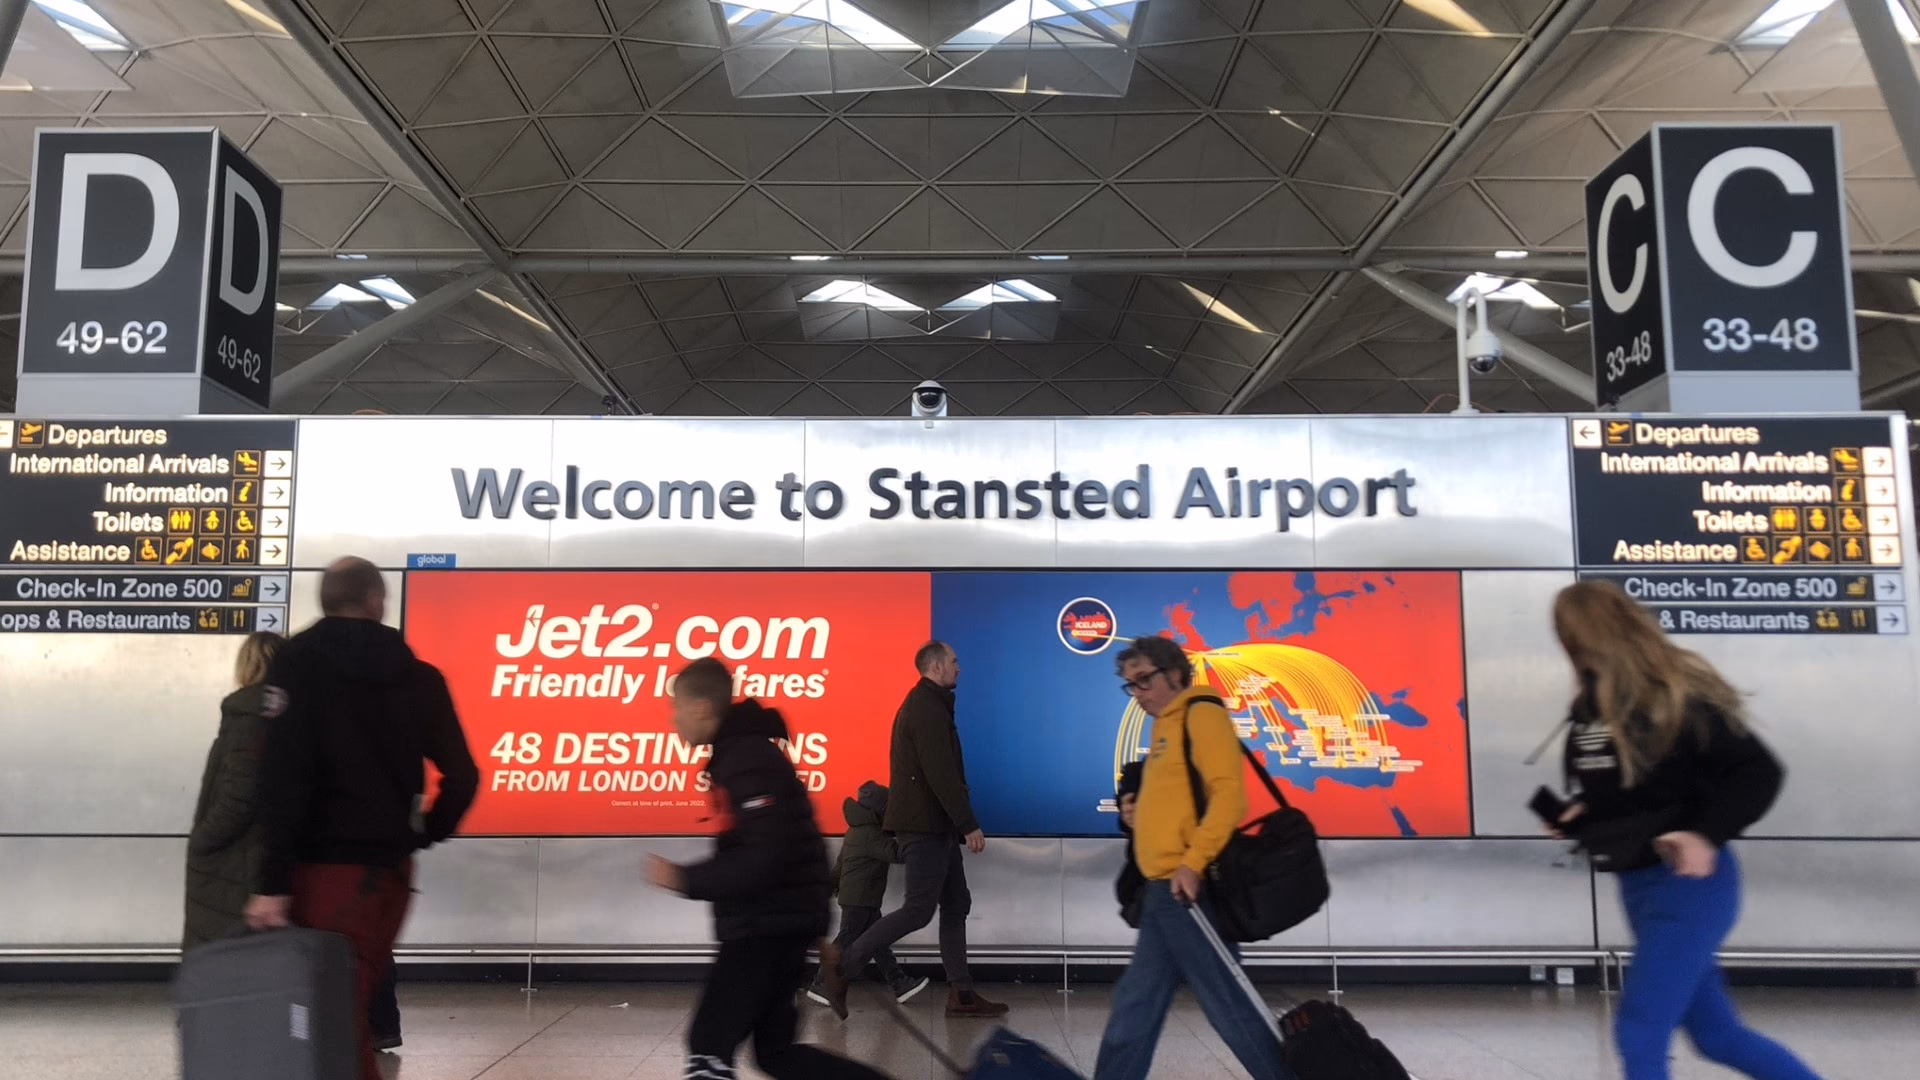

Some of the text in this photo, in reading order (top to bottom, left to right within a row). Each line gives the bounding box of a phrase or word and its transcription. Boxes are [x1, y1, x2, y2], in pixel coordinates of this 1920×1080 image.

[54, 152, 180, 291] D
[1687, 146, 1818, 288] C
[219, 165, 269, 315] D
[1597, 173, 1648, 314] C
[56, 320, 168, 354] 49-62
[1702, 317, 1819, 352] 33-48
[217, 334, 262, 384] 49-62
[1606, 330, 1652, 382] 33-48
[48, 424, 168, 449] Departures
[1635, 423, 1760, 447] Departures
[10, 453, 230, 474] International Arrivals
[1601, 452, 1829, 473] International Arrivals
[104, 482, 229, 503] Information
[451, 463, 1418, 532] Welcome to Stansted Airport
[1702, 481, 1832, 503] Information
[93, 511, 165, 533] Toilets
[1692, 509, 1769, 532] Toilets
[9, 540, 131, 561] Assistance
[417, 554, 446, 567] global
[1613, 540, 1738, 561] Assistance
[16, 578, 222, 598] Check-In Zone 500
[1624, 577, 1837, 598] Check-In Zone 500
[0, 609, 191, 632] ops & Restaurants
[1075, 621, 1107, 629] ICELAND
[1659, 610, 1810, 630] & Restaurants
[496, 604, 830, 660] Jet2.com
[491, 664, 645, 704] Friendly
[731, 664, 826, 698] fares
[489, 731, 543, 765] 48
[491, 769, 570, 792] FROM
[577, 769, 687, 792] LONDON
